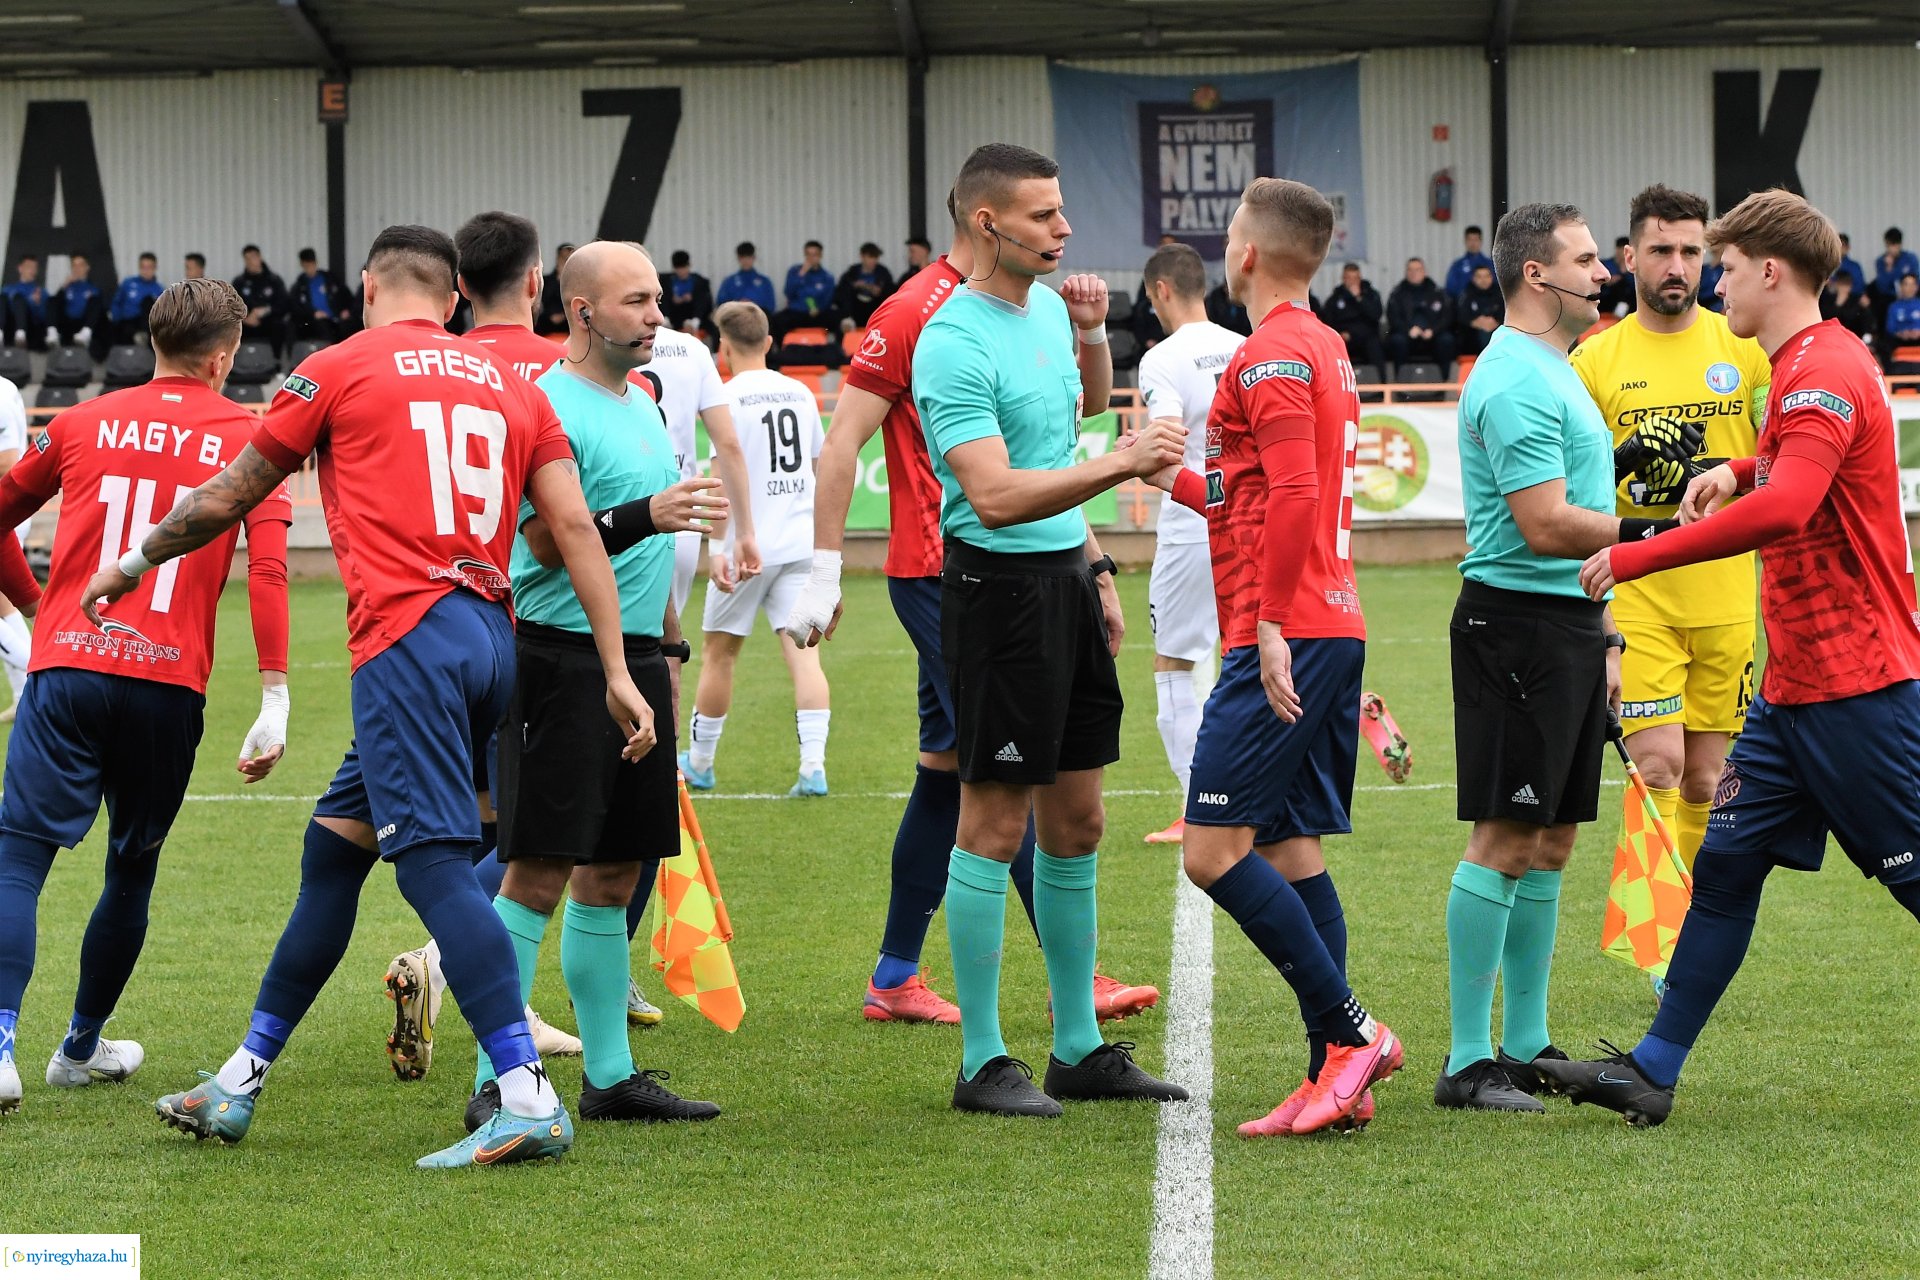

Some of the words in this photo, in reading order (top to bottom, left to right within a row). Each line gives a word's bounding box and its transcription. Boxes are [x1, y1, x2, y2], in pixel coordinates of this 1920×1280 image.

[322, 83, 345, 110] E
[1713, 69, 1821, 217] K
[1159, 143, 1256, 192] NEM
[2, 100, 118, 298] A
[1619, 381, 1648, 392] JAKO
[1617, 400, 1744, 427] CREDOBUS
[97, 419, 193, 457] NAGY
[198, 433, 228, 469] B.
[761, 408, 802, 473] 19
[408, 401, 508, 545] 19
[766, 478, 806, 496] SZALKA
[96, 474, 196, 614] 14
[55, 631, 120, 651] LERTON
[123, 639, 180, 661] TRANS
[994, 753, 1024, 763] adidas
[1197, 792, 1229, 805] JAKO
[1511, 795, 1540, 805] adidas
[1882, 851, 1914, 869] JAKO
